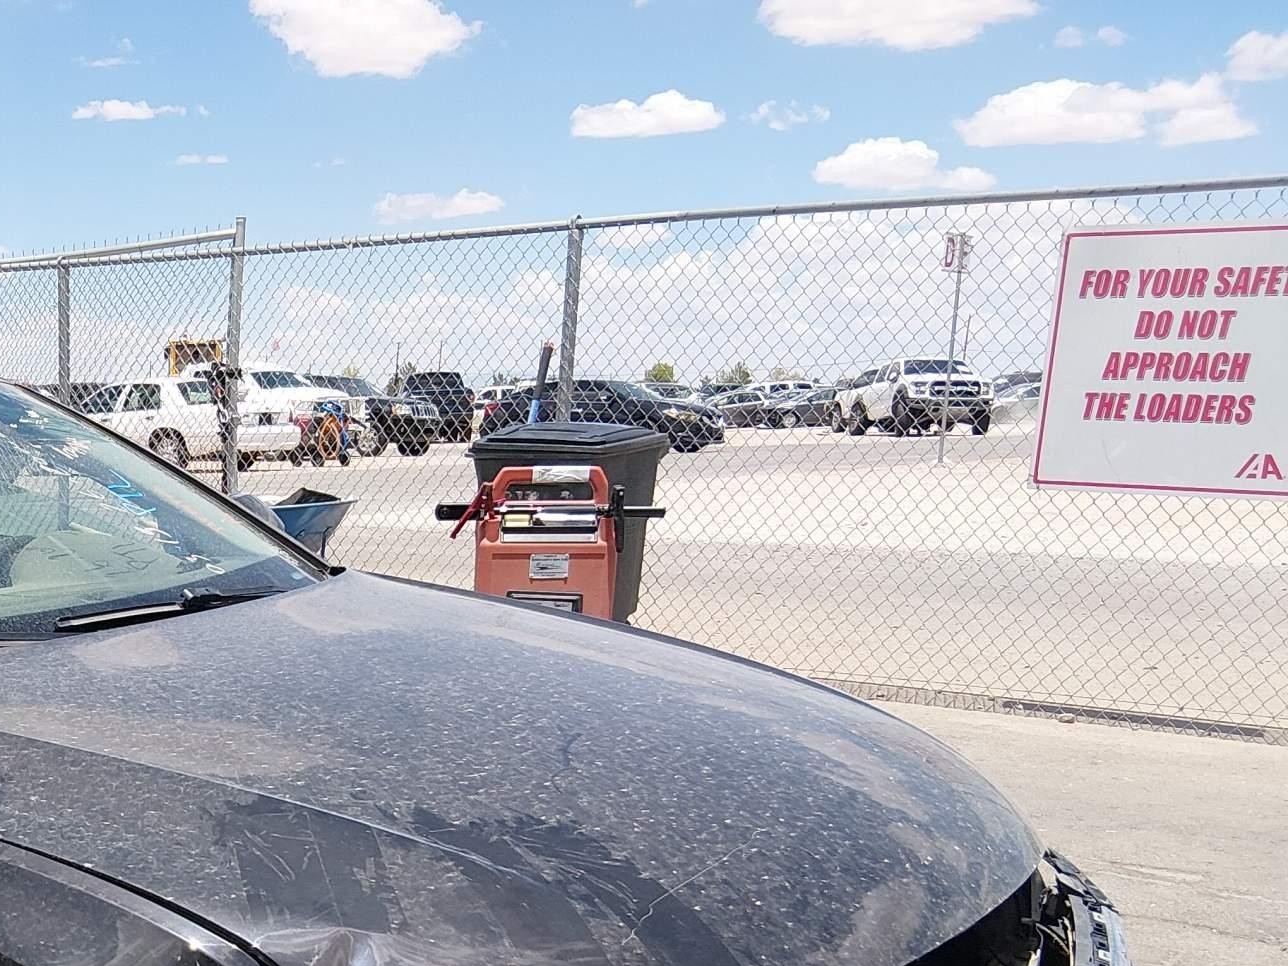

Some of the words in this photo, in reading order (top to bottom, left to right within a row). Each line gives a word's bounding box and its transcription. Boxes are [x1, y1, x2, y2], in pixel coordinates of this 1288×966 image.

[1079, 269, 1131, 299] FOR
[1137, 267, 1210, 299] YOUR
[1214, 266, 1288, 298] SAFE
[1134, 310, 1175, 340] DO
[1177, 309, 1238, 340] NOT
[1101, 351, 1252, 382] APPROACH
[1082, 392, 1132, 421] THE
[1133, 393, 1256, 425] LOADERS
